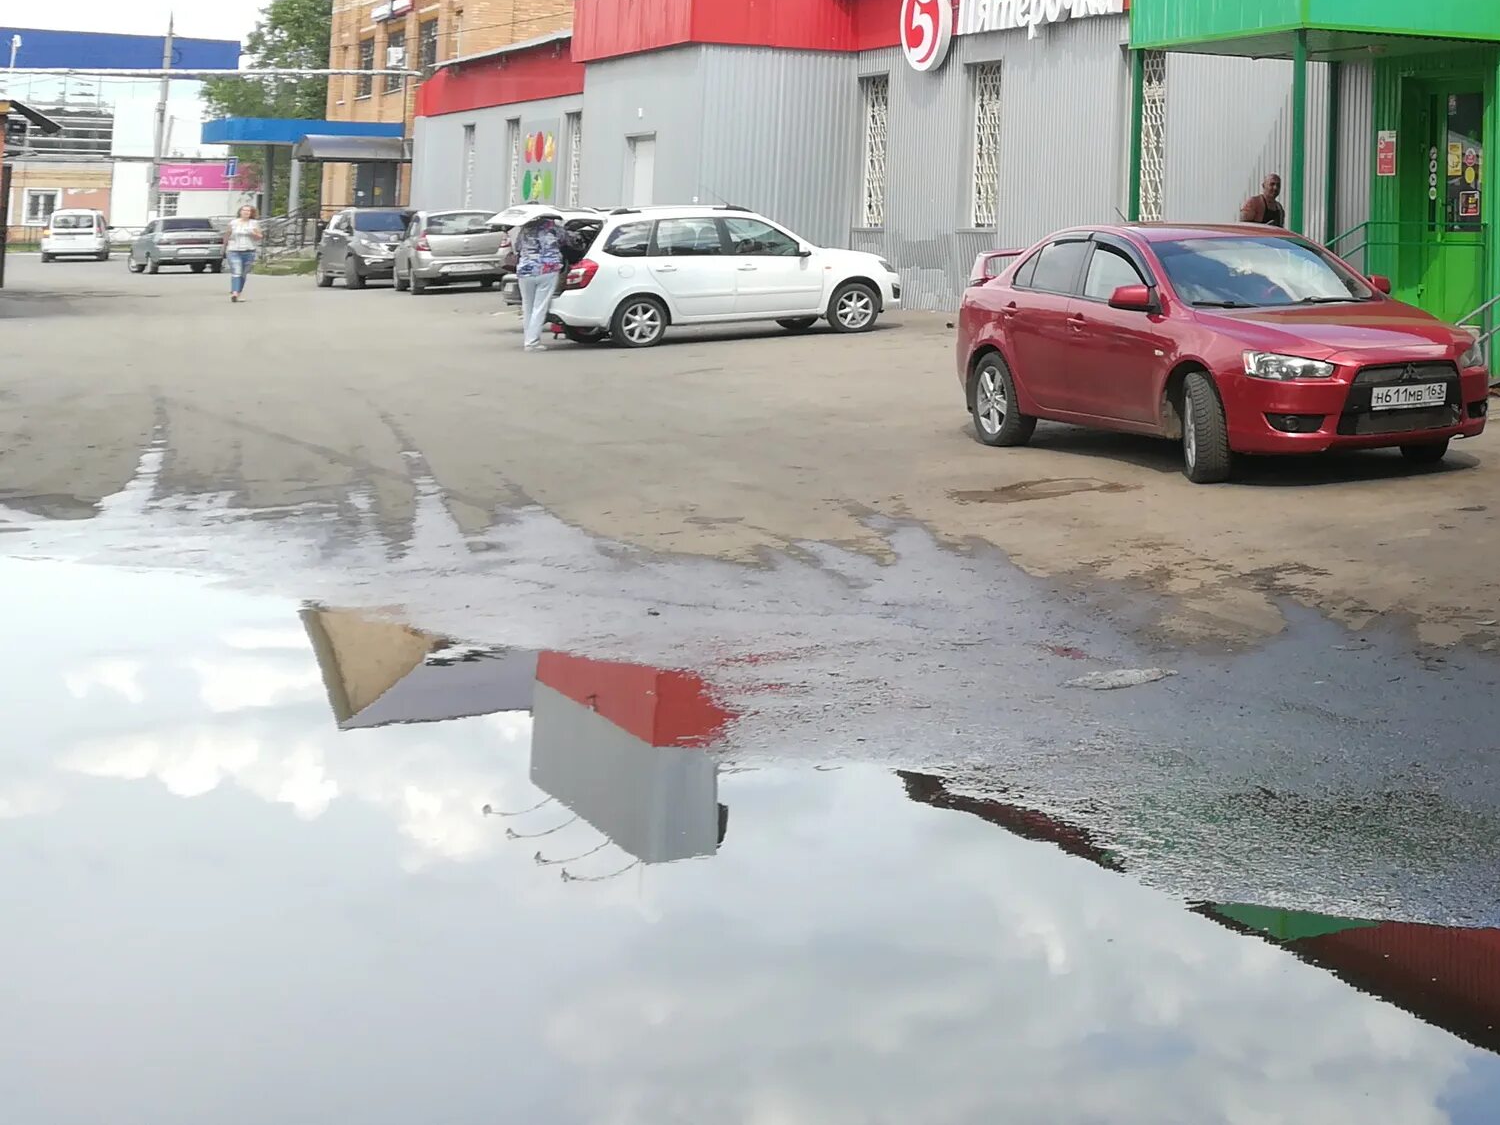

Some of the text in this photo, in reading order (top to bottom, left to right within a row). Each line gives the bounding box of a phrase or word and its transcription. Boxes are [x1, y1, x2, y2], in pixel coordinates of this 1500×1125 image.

[908, 0, 934, 63] 5
[159, 176, 203, 186] AVON
[1426, 384, 1444, 396] 163
